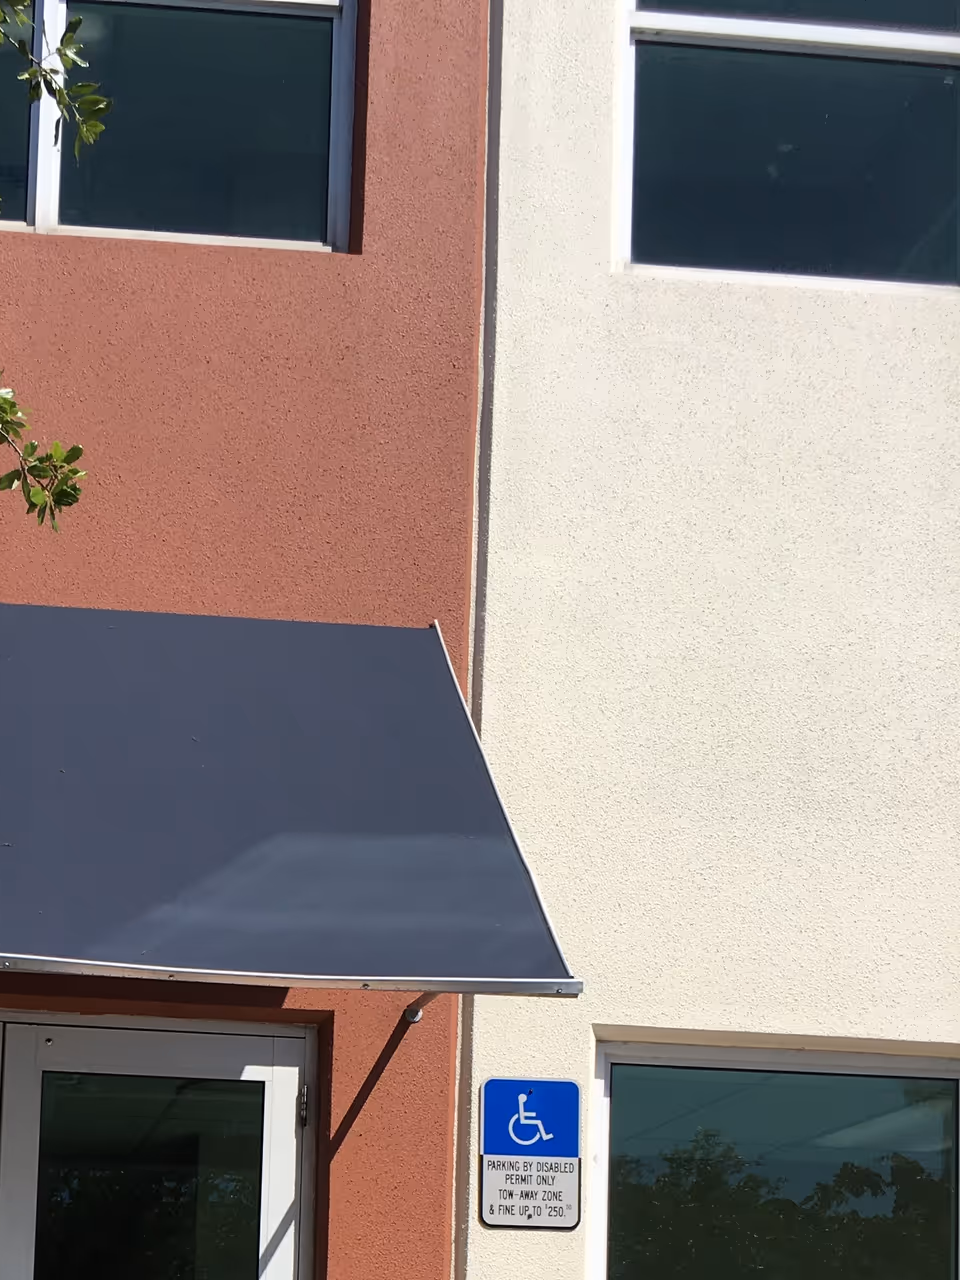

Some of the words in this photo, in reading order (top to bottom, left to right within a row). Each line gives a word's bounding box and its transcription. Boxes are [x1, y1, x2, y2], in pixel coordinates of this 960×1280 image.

[487, 1160, 520, 1172] PARKING
[522, 1161, 534, 1172] BY
[536, 1162, 575, 1174] DISABLED
[505, 1174, 533, 1185] PERMIT
[536, 1175, 556, 1186] ONLY
[498, 1189, 538, 1201] TOW-AWAY
[541, 1191, 563, 1202] ZONE
[489, 1204, 495, 1215] &
[498, 1205, 516, 1216] FINE
[519, 1206, 529, 1216] UP
[532, 1206, 542, 1217] TO
